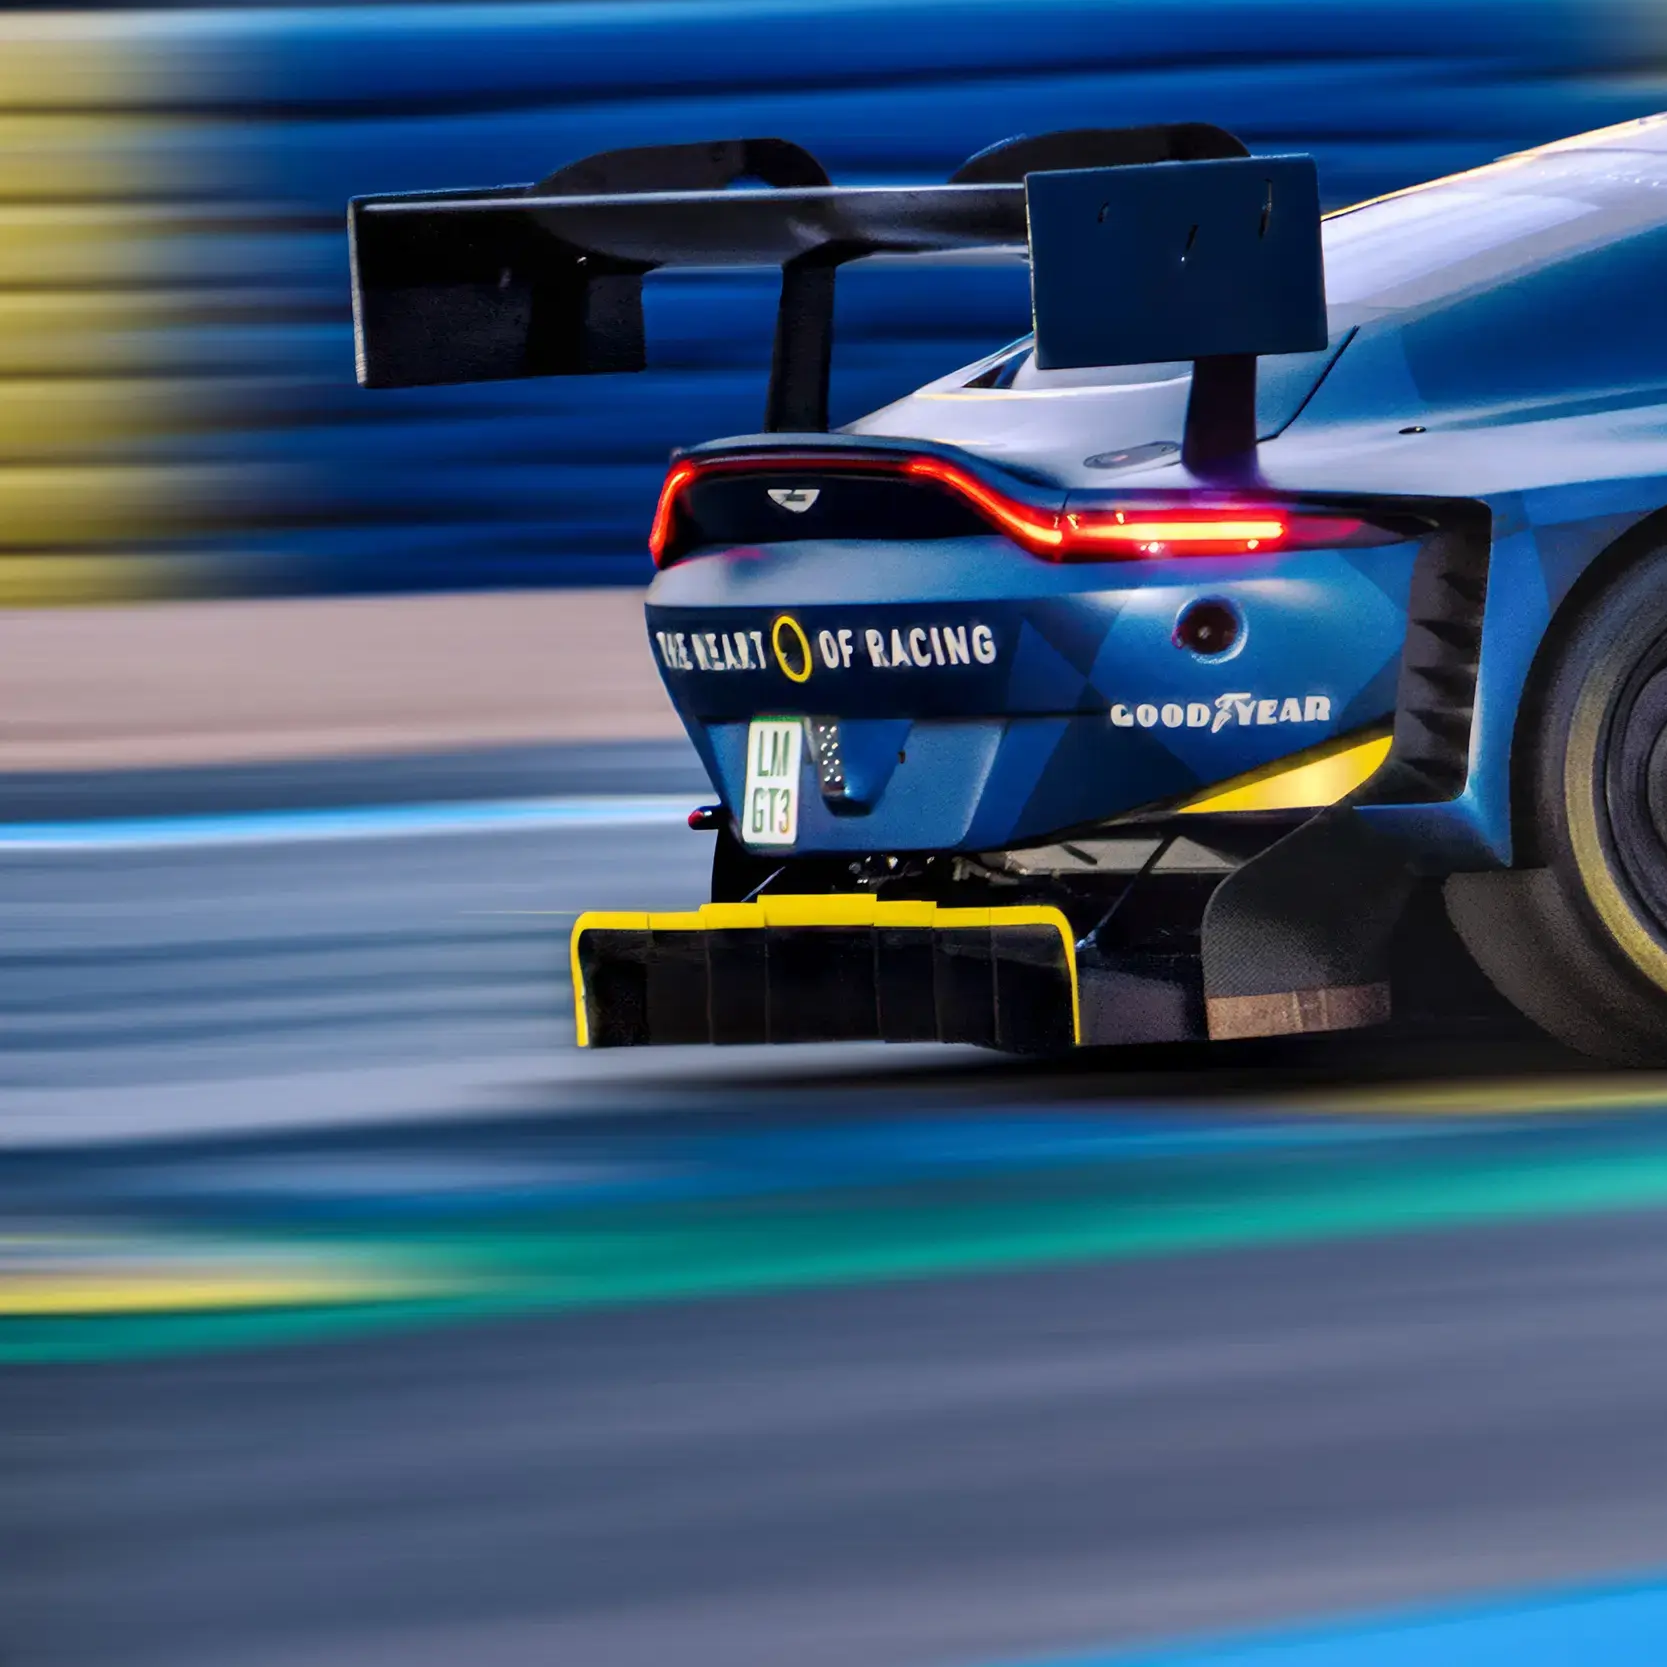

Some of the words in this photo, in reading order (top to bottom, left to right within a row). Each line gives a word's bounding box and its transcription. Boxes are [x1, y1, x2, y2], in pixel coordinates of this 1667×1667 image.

[818, 629, 854, 669] OF
[864, 624, 998, 668] RACING
[751, 786, 791, 834] GT3
